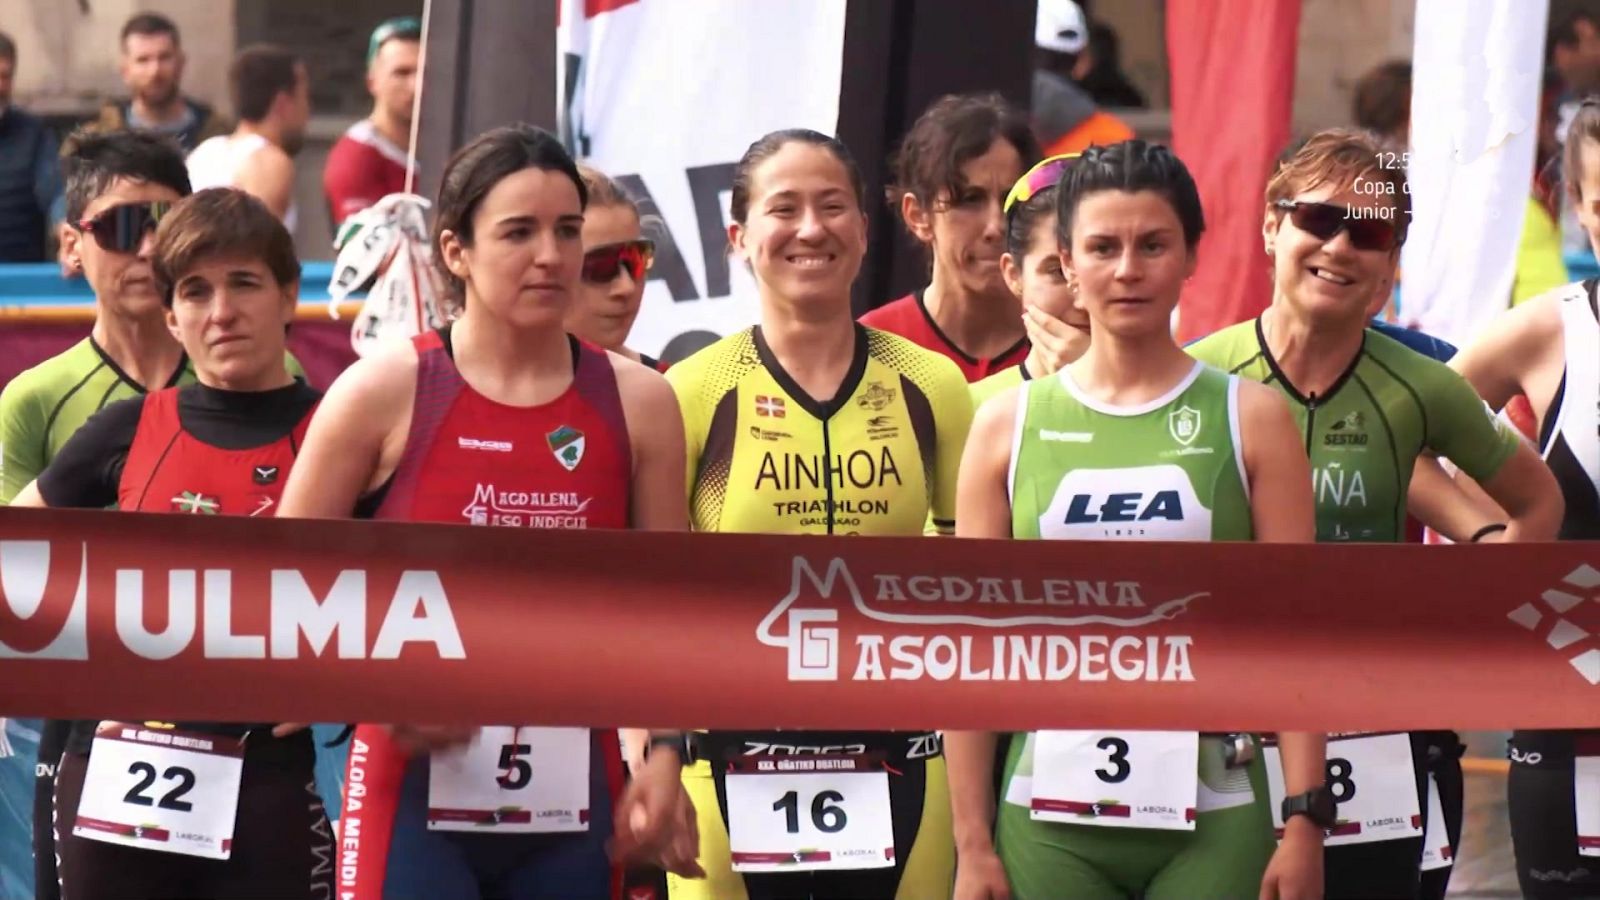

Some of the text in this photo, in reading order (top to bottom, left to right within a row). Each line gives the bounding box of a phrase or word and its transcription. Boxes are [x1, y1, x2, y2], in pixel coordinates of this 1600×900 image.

[1324, 433, 1368, 446] SESTAO
[754, 446, 902, 490] AINHOA
[773, 500, 889, 516] TRIATHLON
[1064, 490, 1184, 525] LEA
[790, 556, 1147, 608] MAGDALENA
[115, 569, 467, 660] ULMA
[788, 609, 1197, 681] GASOLINDEGIA
[346, 739, 370, 812] ALOÑA
[496, 744, 532, 790] 5
[1095, 737, 1131, 783] 3
[1325, 757, 1356, 804] 8
[123, 761, 196, 813] 22
[773, 789, 848, 834] 16
[341, 817, 361, 886] MENDI
